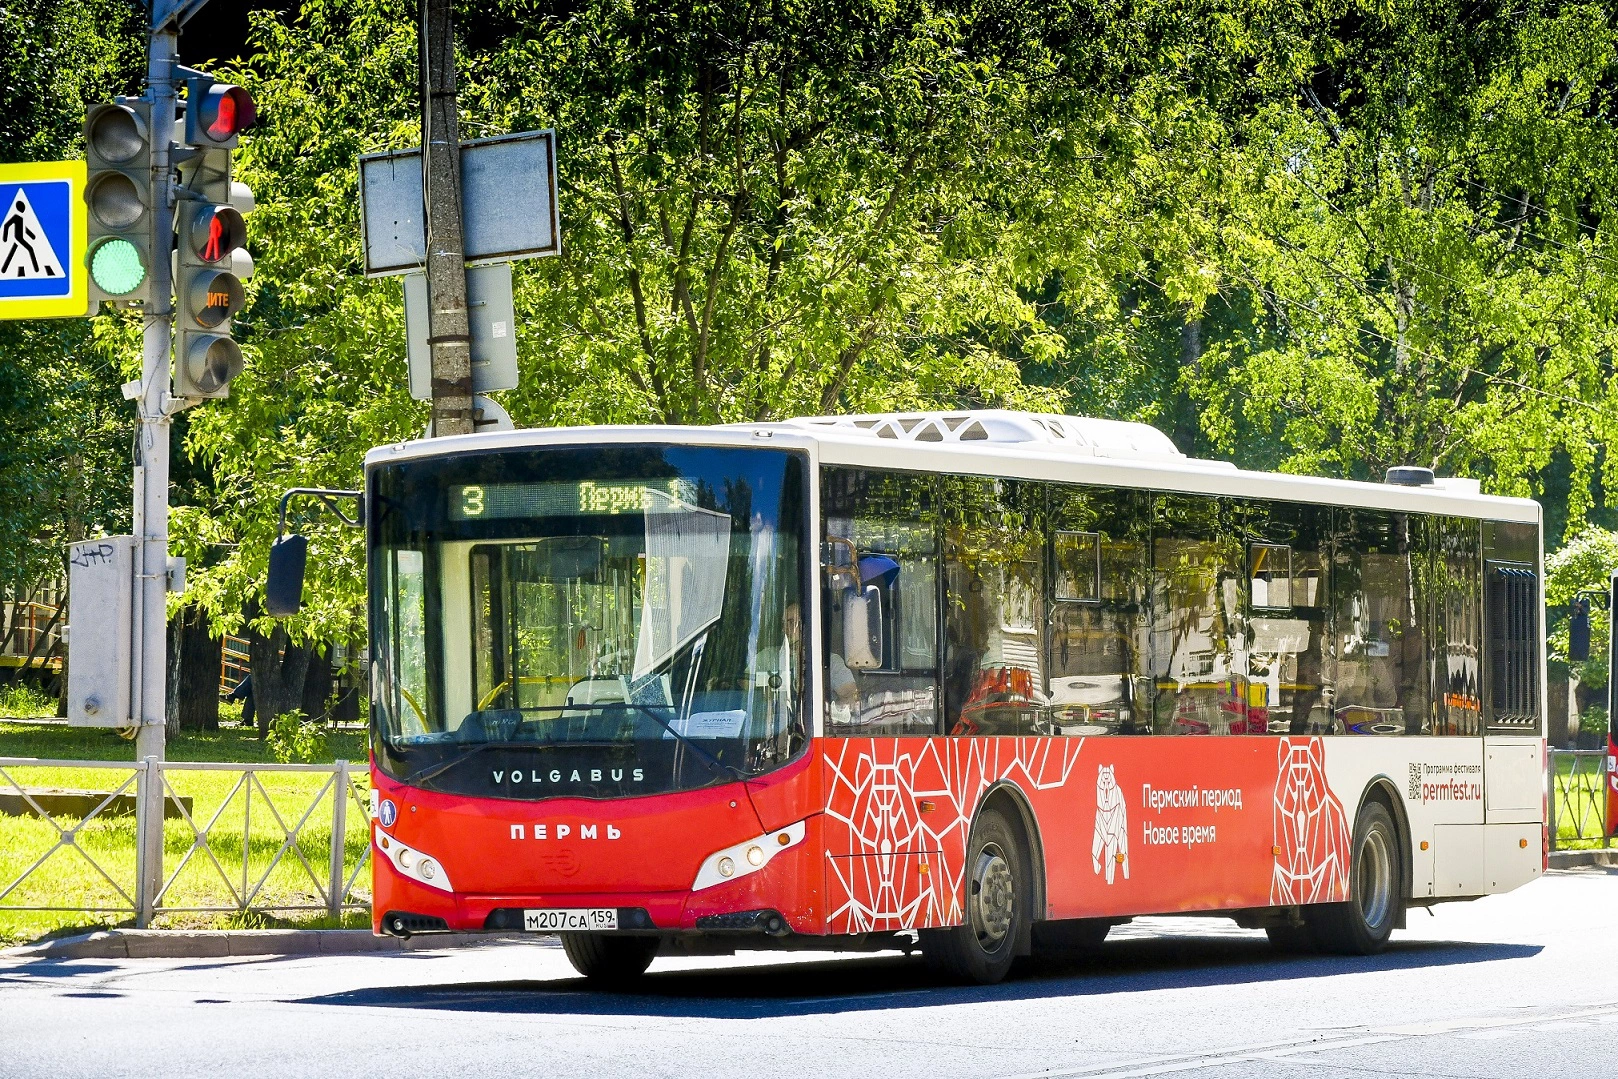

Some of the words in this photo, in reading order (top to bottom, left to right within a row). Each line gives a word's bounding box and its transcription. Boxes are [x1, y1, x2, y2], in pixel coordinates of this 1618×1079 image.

[462, 486, 484, 515] 3
[579, 481, 653, 514] Пермь
[492, 768, 645, 783] VOLGABUS
[1423, 763, 1453, 776] Программа
[1453, 763, 1481, 776] фестиваля
[1142, 783, 1199, 815] Пермский
[1201, 788, 1243, 813] период
[1423, 778, 1481, 805] permfest.ru
[510, 824, 621, 840] ПЕРМЬ
[1143, 820, 1180, 845] Новое
[1181, 825, 1216, 850] время
[590, 910, 613, 924] 159
